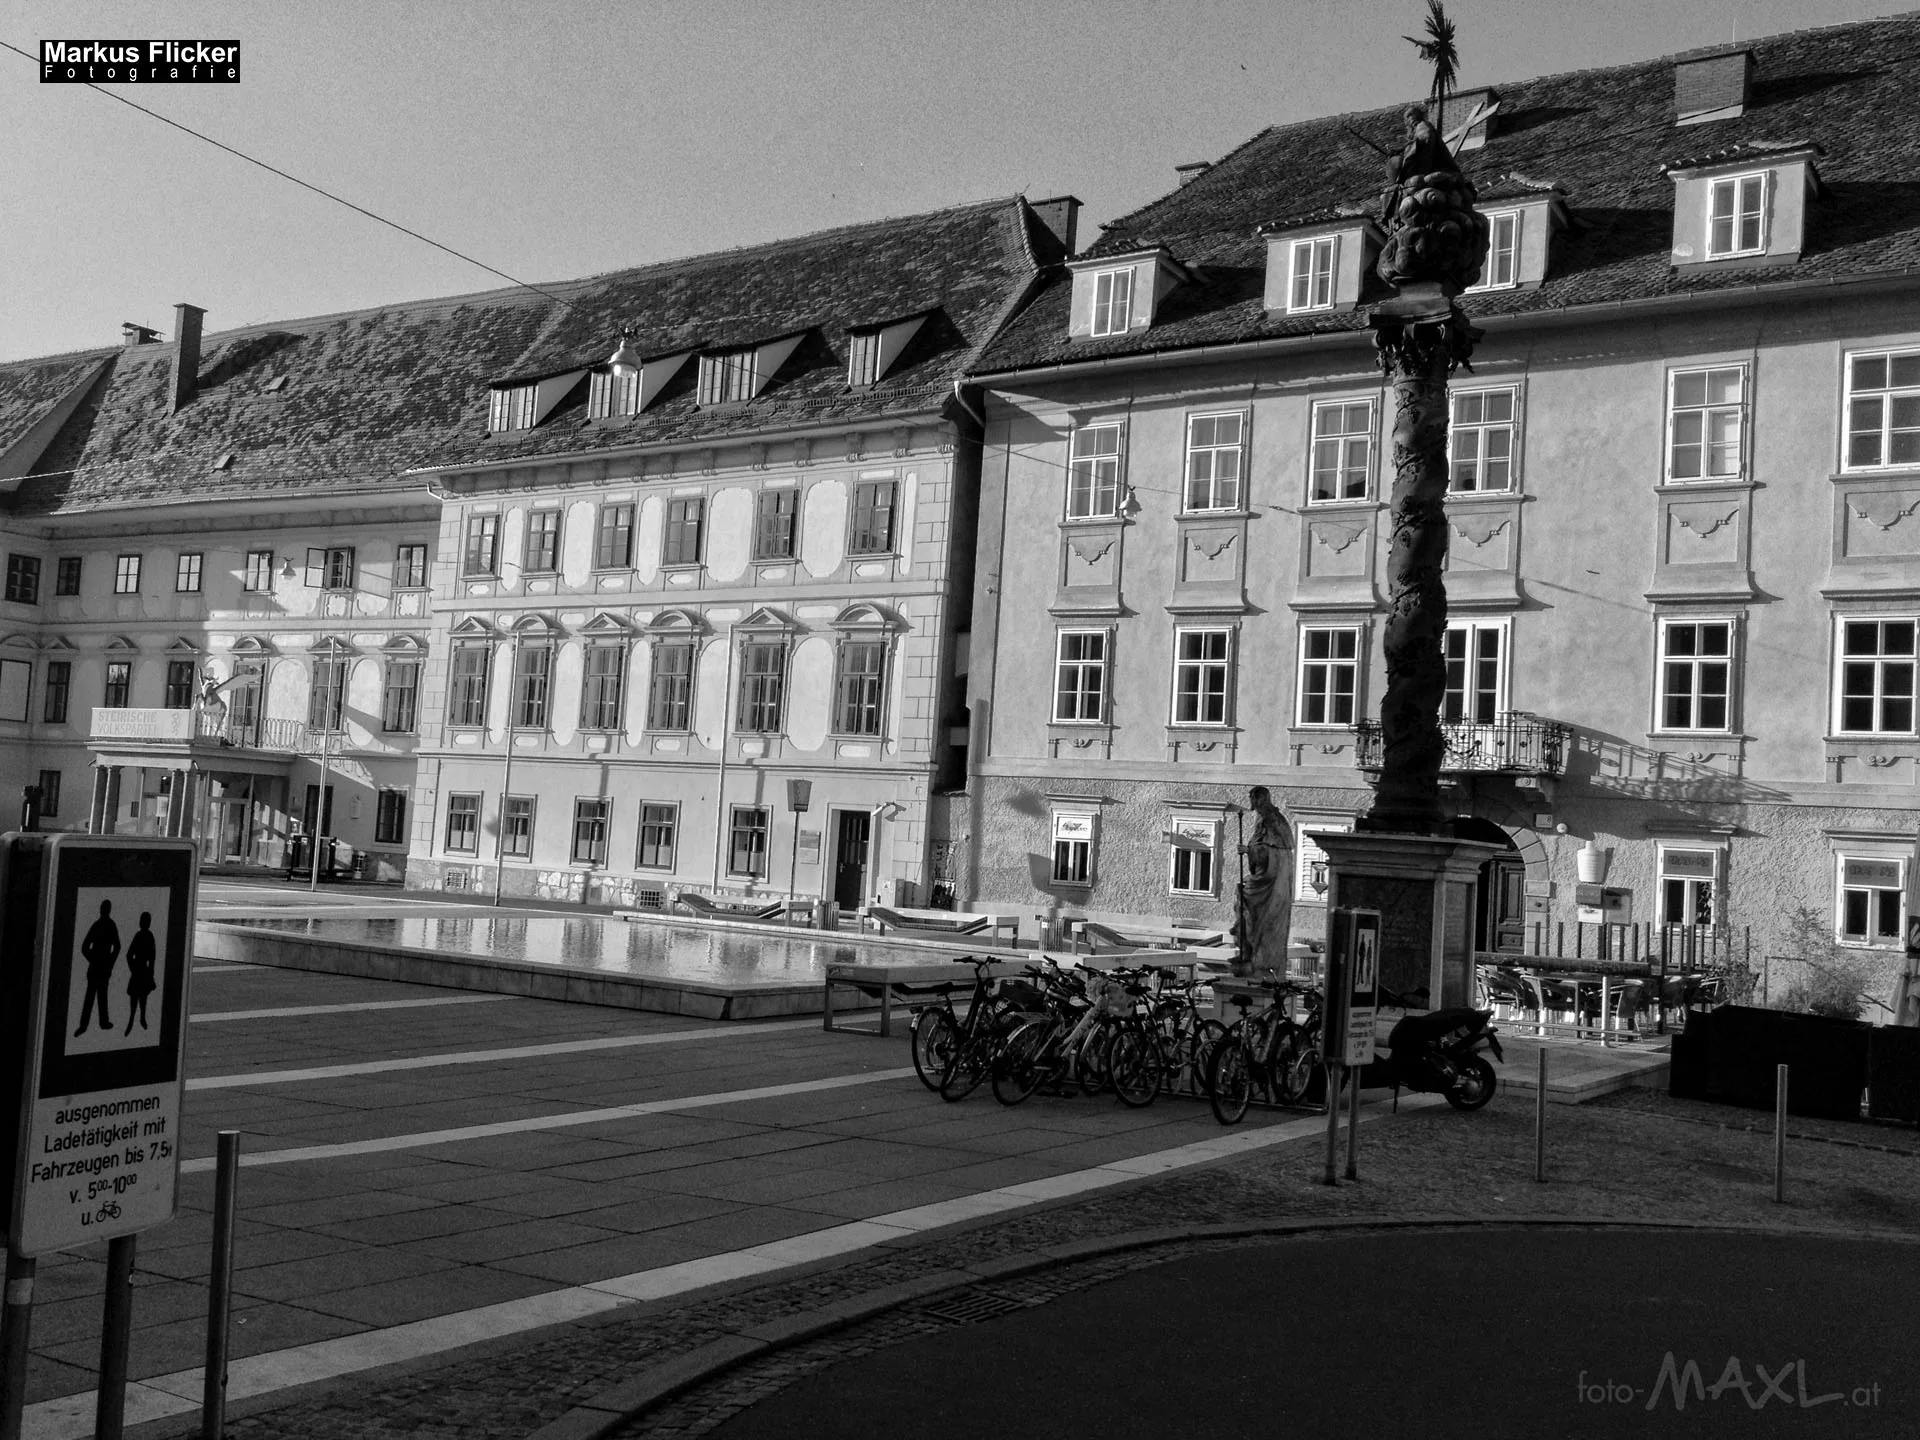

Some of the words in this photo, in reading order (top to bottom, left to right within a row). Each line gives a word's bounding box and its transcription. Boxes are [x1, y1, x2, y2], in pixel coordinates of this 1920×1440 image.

[55, 1096, 160, 1125] ausgenommen
[44, 1120, 138, 1153] Ladetätigkeit
[144, 1116, 166, 1137] mit
[31, 1154, 120, 1183] Fahrzeugen
[125, 1146, 144, 1165] bis
[69, 1188, 82, 1204] v.
[81, 1212, 94, 1226] u.
